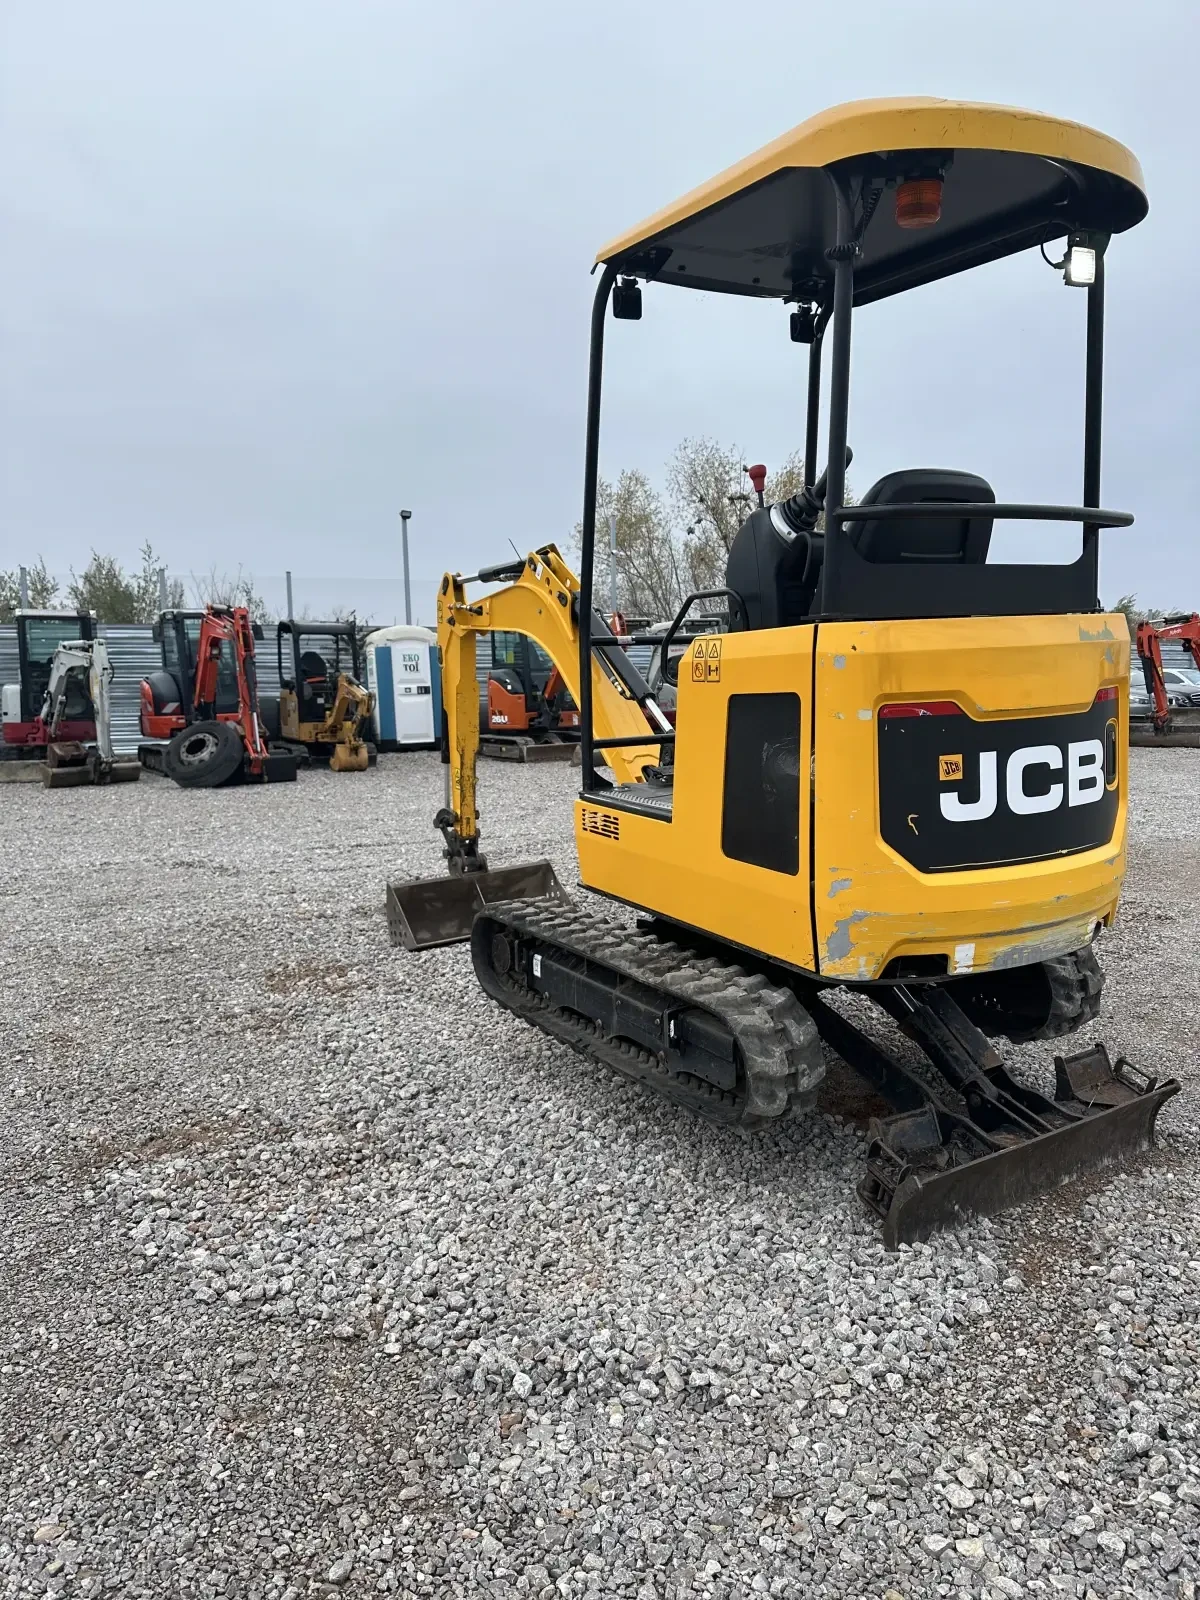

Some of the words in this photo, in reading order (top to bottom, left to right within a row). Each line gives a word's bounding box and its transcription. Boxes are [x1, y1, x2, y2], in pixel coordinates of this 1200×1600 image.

[402, 653, 420, 662] EKO
[944, 761, 960, 776] JCB
[939, 739, 1105, 822] JCB
